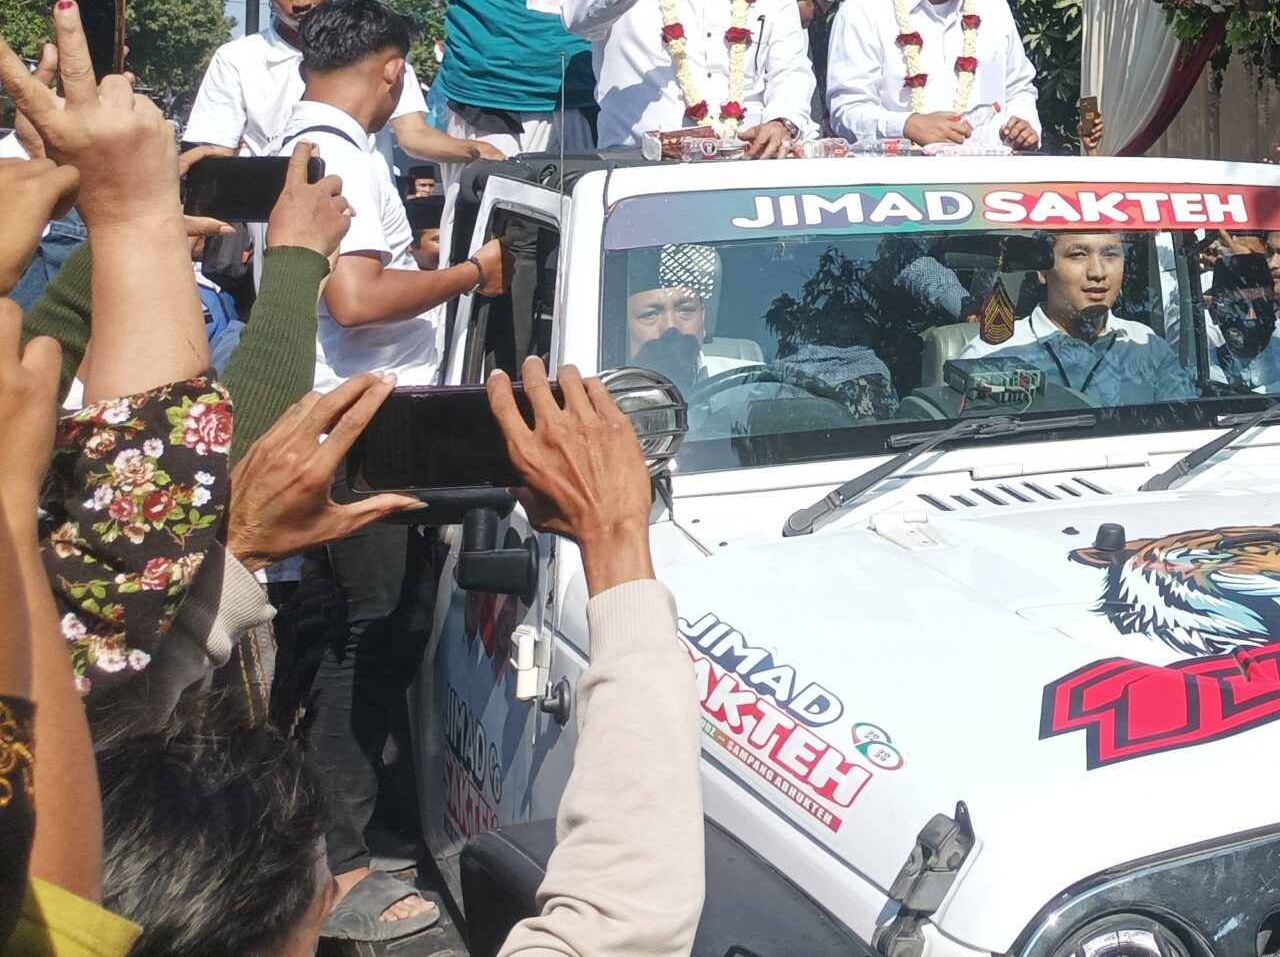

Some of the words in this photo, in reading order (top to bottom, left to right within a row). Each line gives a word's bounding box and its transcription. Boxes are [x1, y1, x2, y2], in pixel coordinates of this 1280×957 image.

[731, 190, 973, 228] JIMAD
[981, 190, 1250, 225] SAKTEH
[678, 612, 844, 727] JIMAD
[677, 635, 873, 808] AKTEH
[727, 740, 774, 781] SAMPANG
